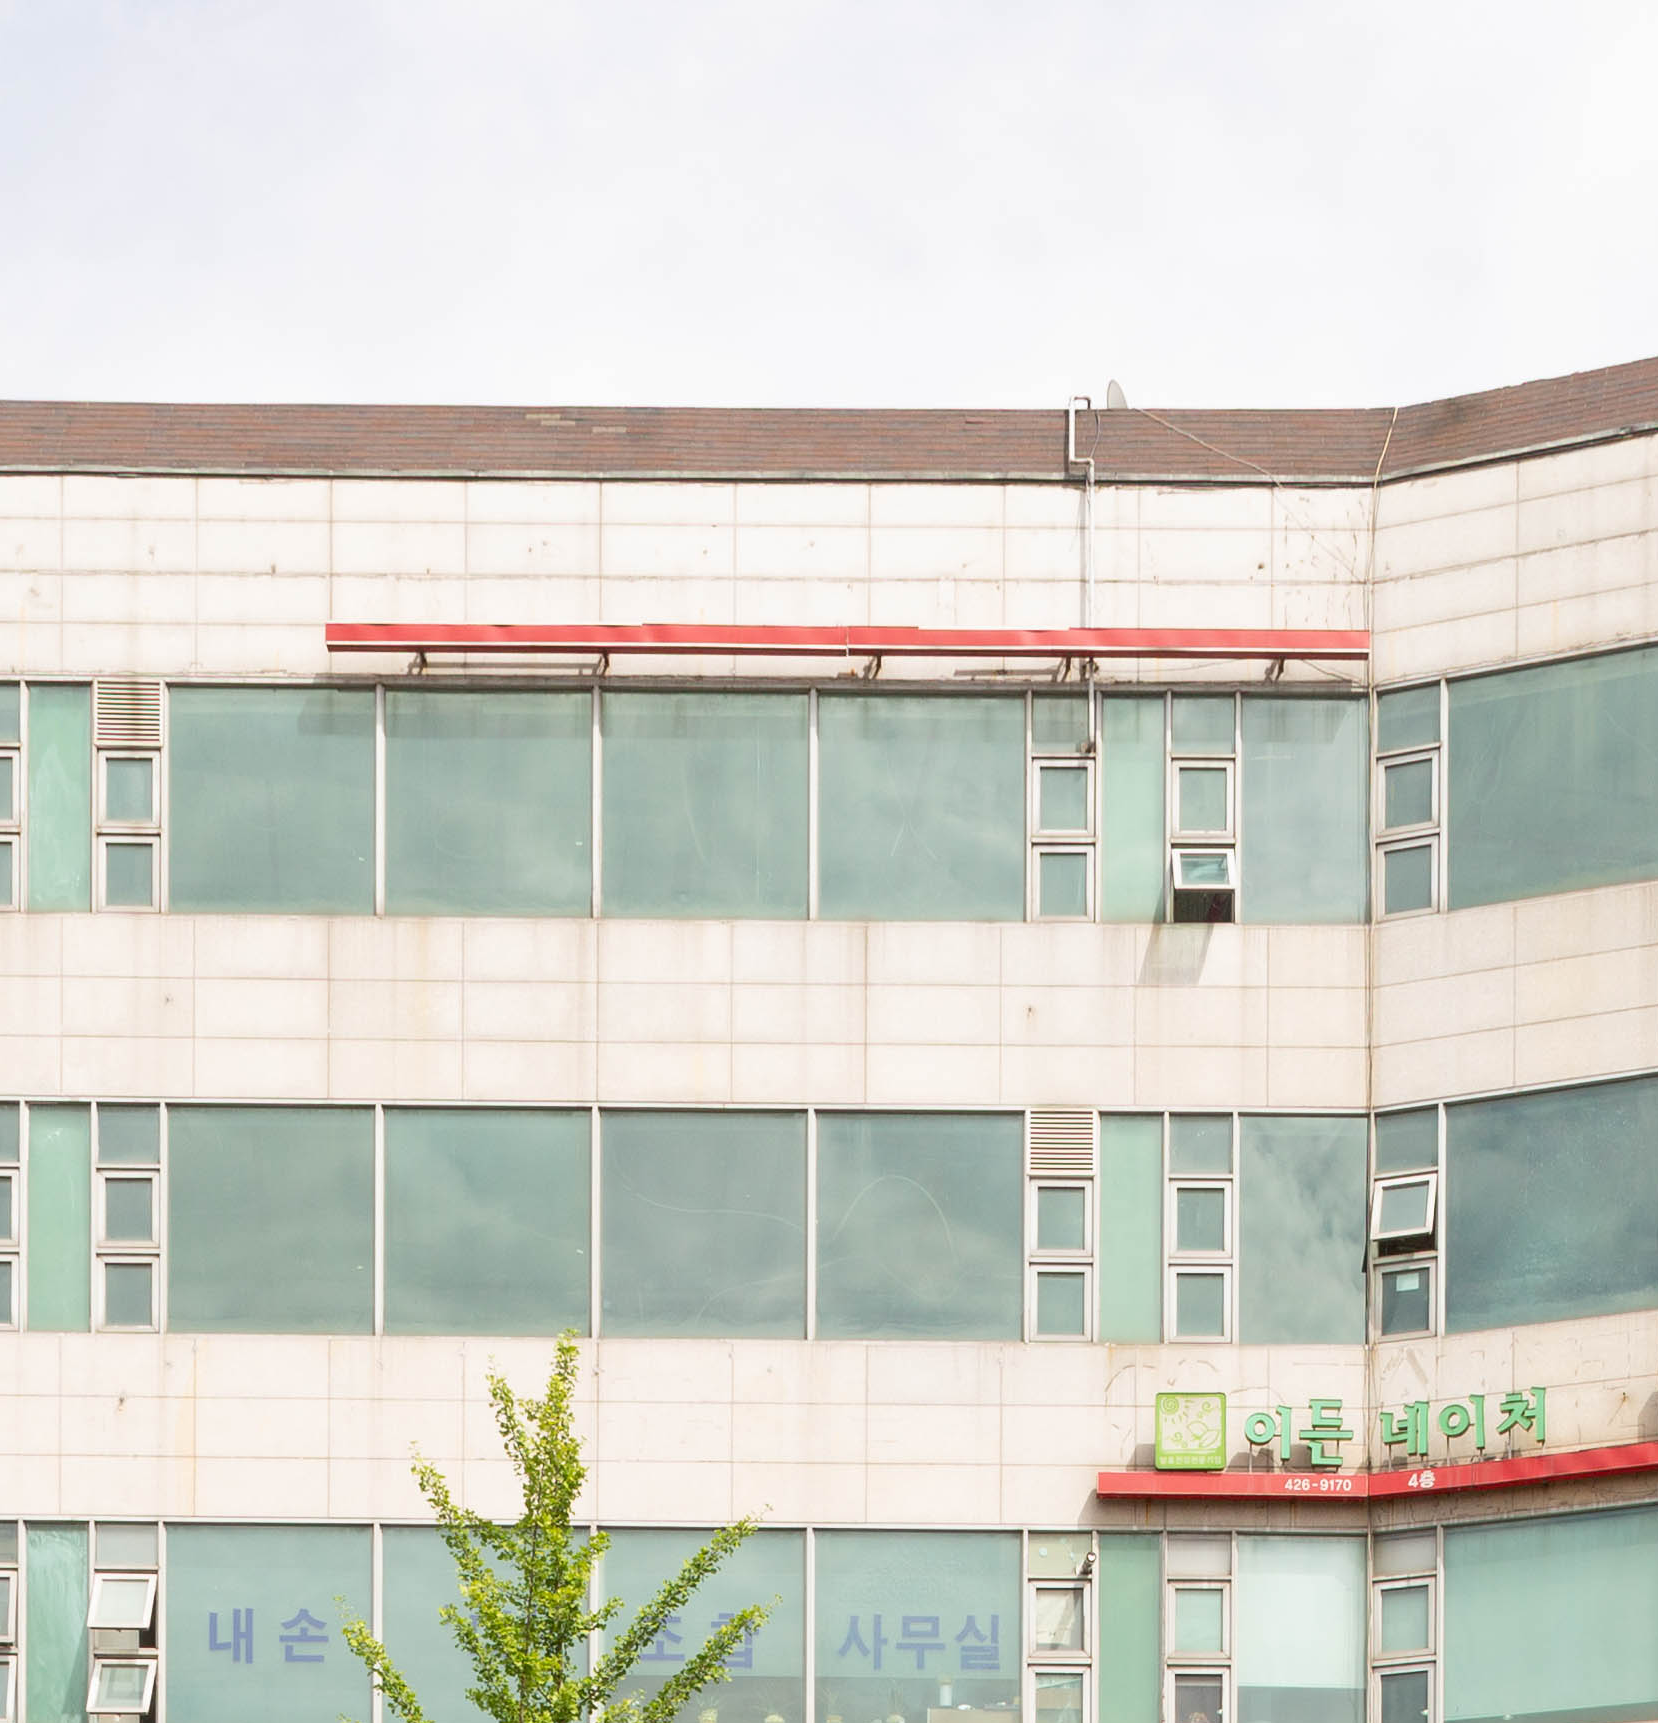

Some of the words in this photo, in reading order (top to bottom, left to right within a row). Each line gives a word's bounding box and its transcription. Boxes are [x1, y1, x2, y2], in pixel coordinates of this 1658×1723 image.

[1245, 1398, 1354, 1467] 이든
[1379, 1386, 1547, 1460] 네이처
[1284, 1479, 1352, 1492] 426-9170
[1407, 1471, 1436, 1489] 4층
[838, 1612, 1003, 1673] 사무실
